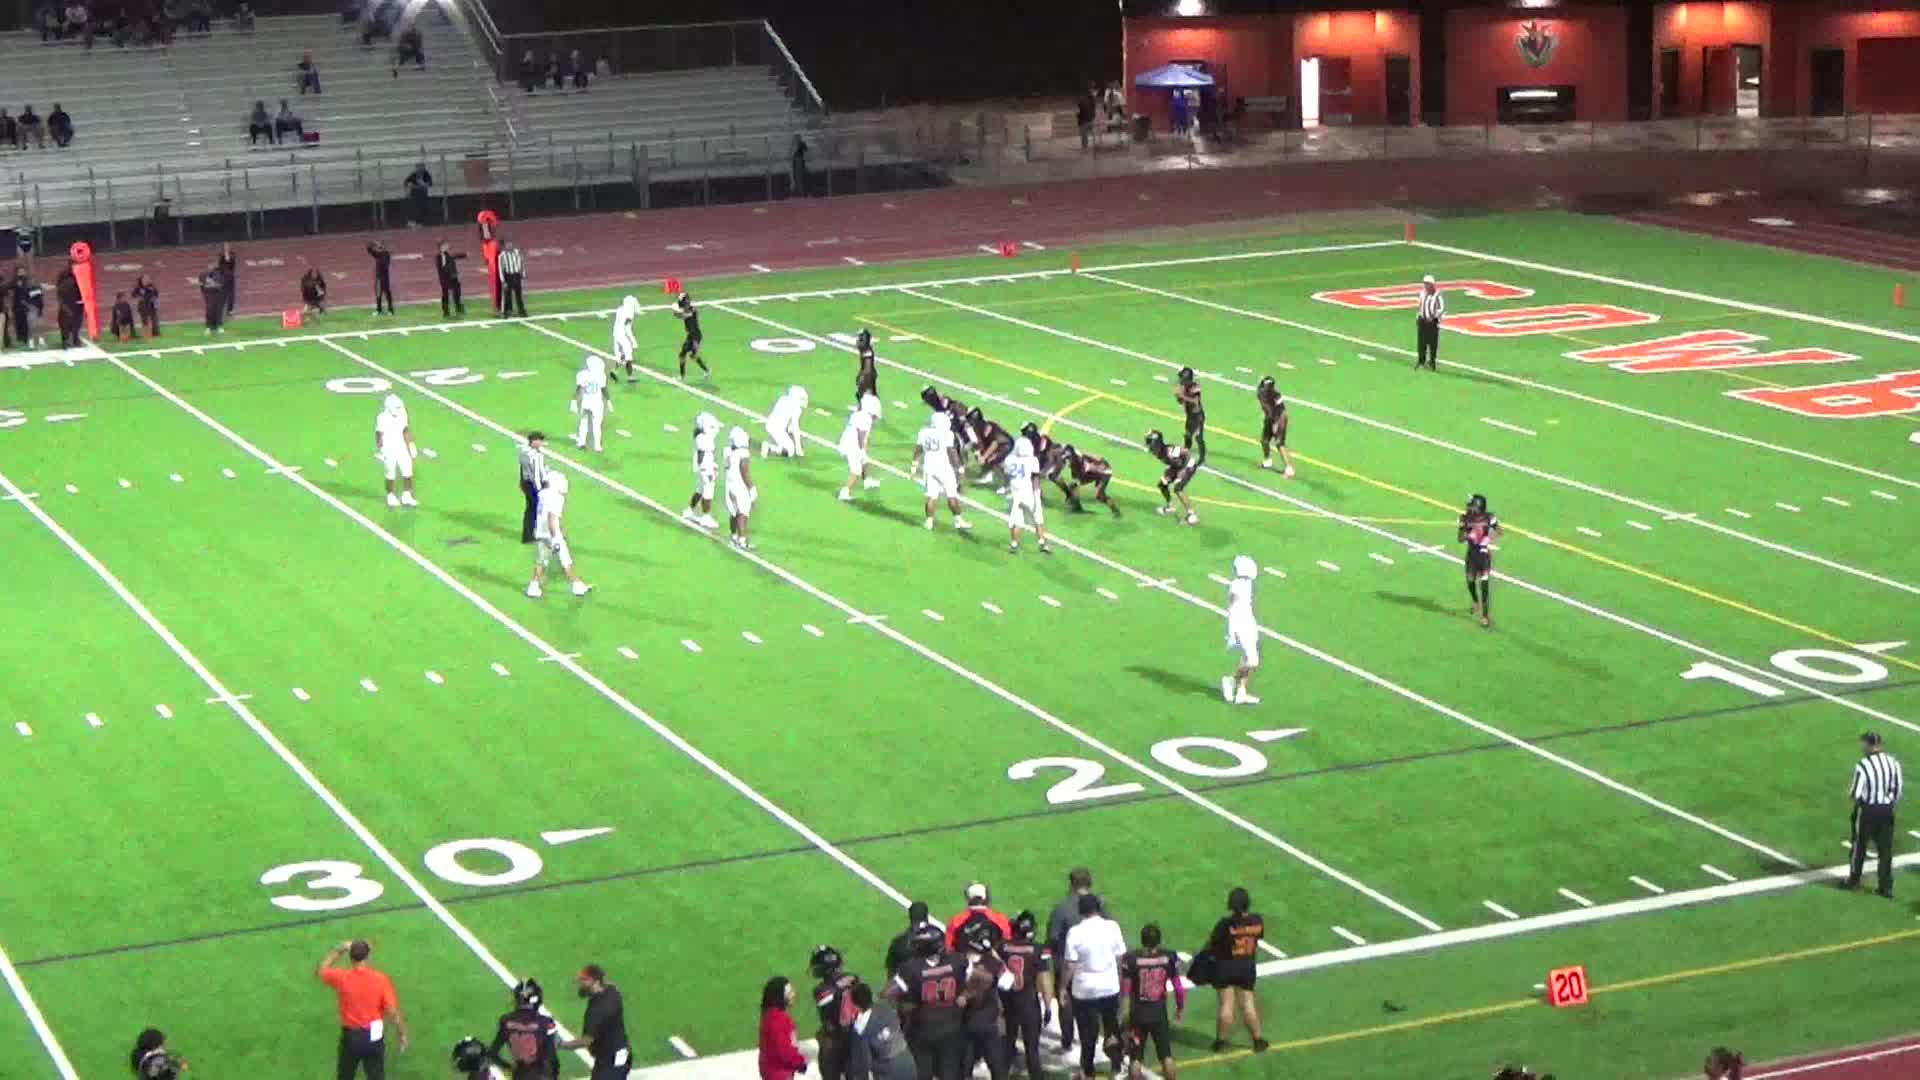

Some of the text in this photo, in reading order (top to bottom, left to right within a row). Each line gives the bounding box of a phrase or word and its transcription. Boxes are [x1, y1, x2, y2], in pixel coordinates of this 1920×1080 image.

[1008, 463, 1026, 479] 24
[1679, 648, 1888, 697] 10
[1007, 736, 1268, 804] 20
[260, 837, 542, 911] 30
[1555, 972, 1583, 1003] 20
